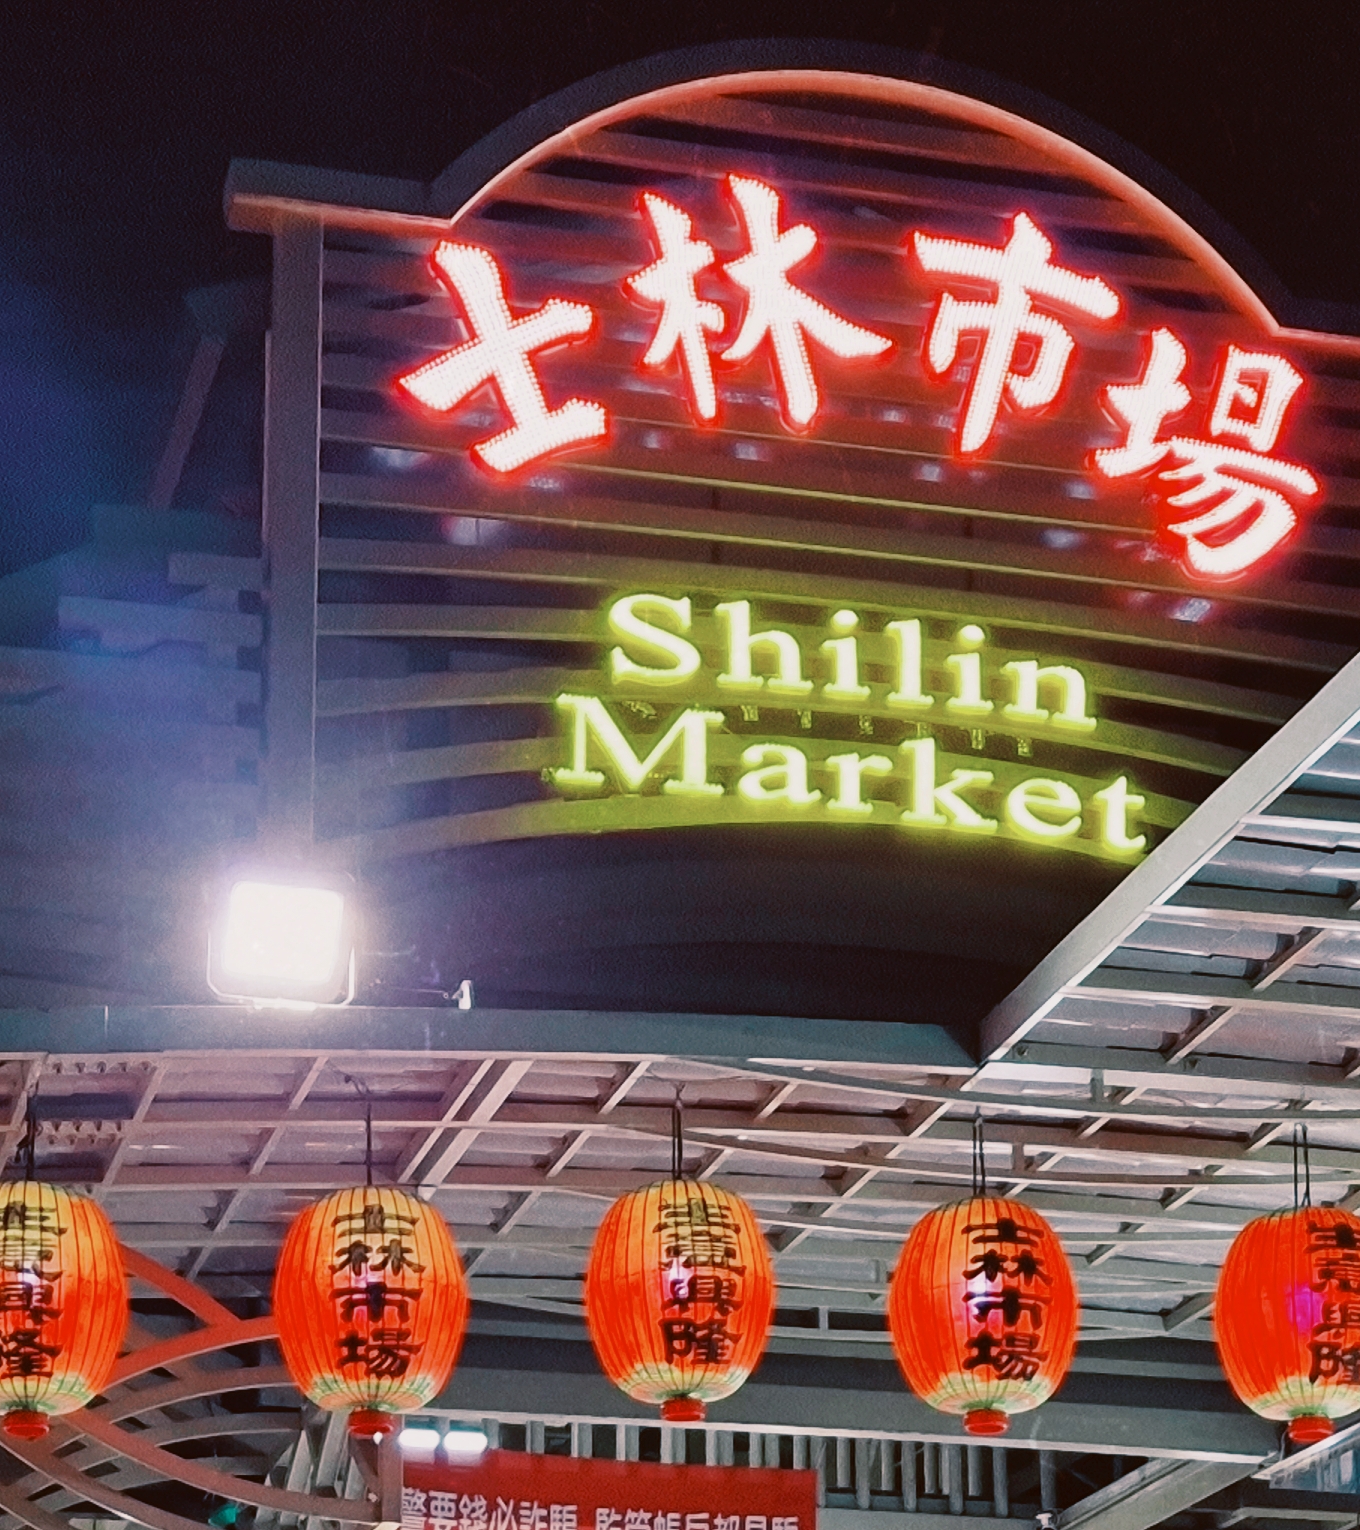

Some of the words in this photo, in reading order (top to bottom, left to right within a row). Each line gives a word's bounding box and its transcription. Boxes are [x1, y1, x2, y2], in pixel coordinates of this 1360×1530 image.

[396, 172, 1320, 576] 士林市場
[608, 592, 1098, 732] Shilin
[550, 692, 1148, 854] Market
[330, 1203, 426, 1379] 士林市場
[654, 1197, 748, 1368] 生意興隆
[962, 1217, 1054, 1383] 士林市場
